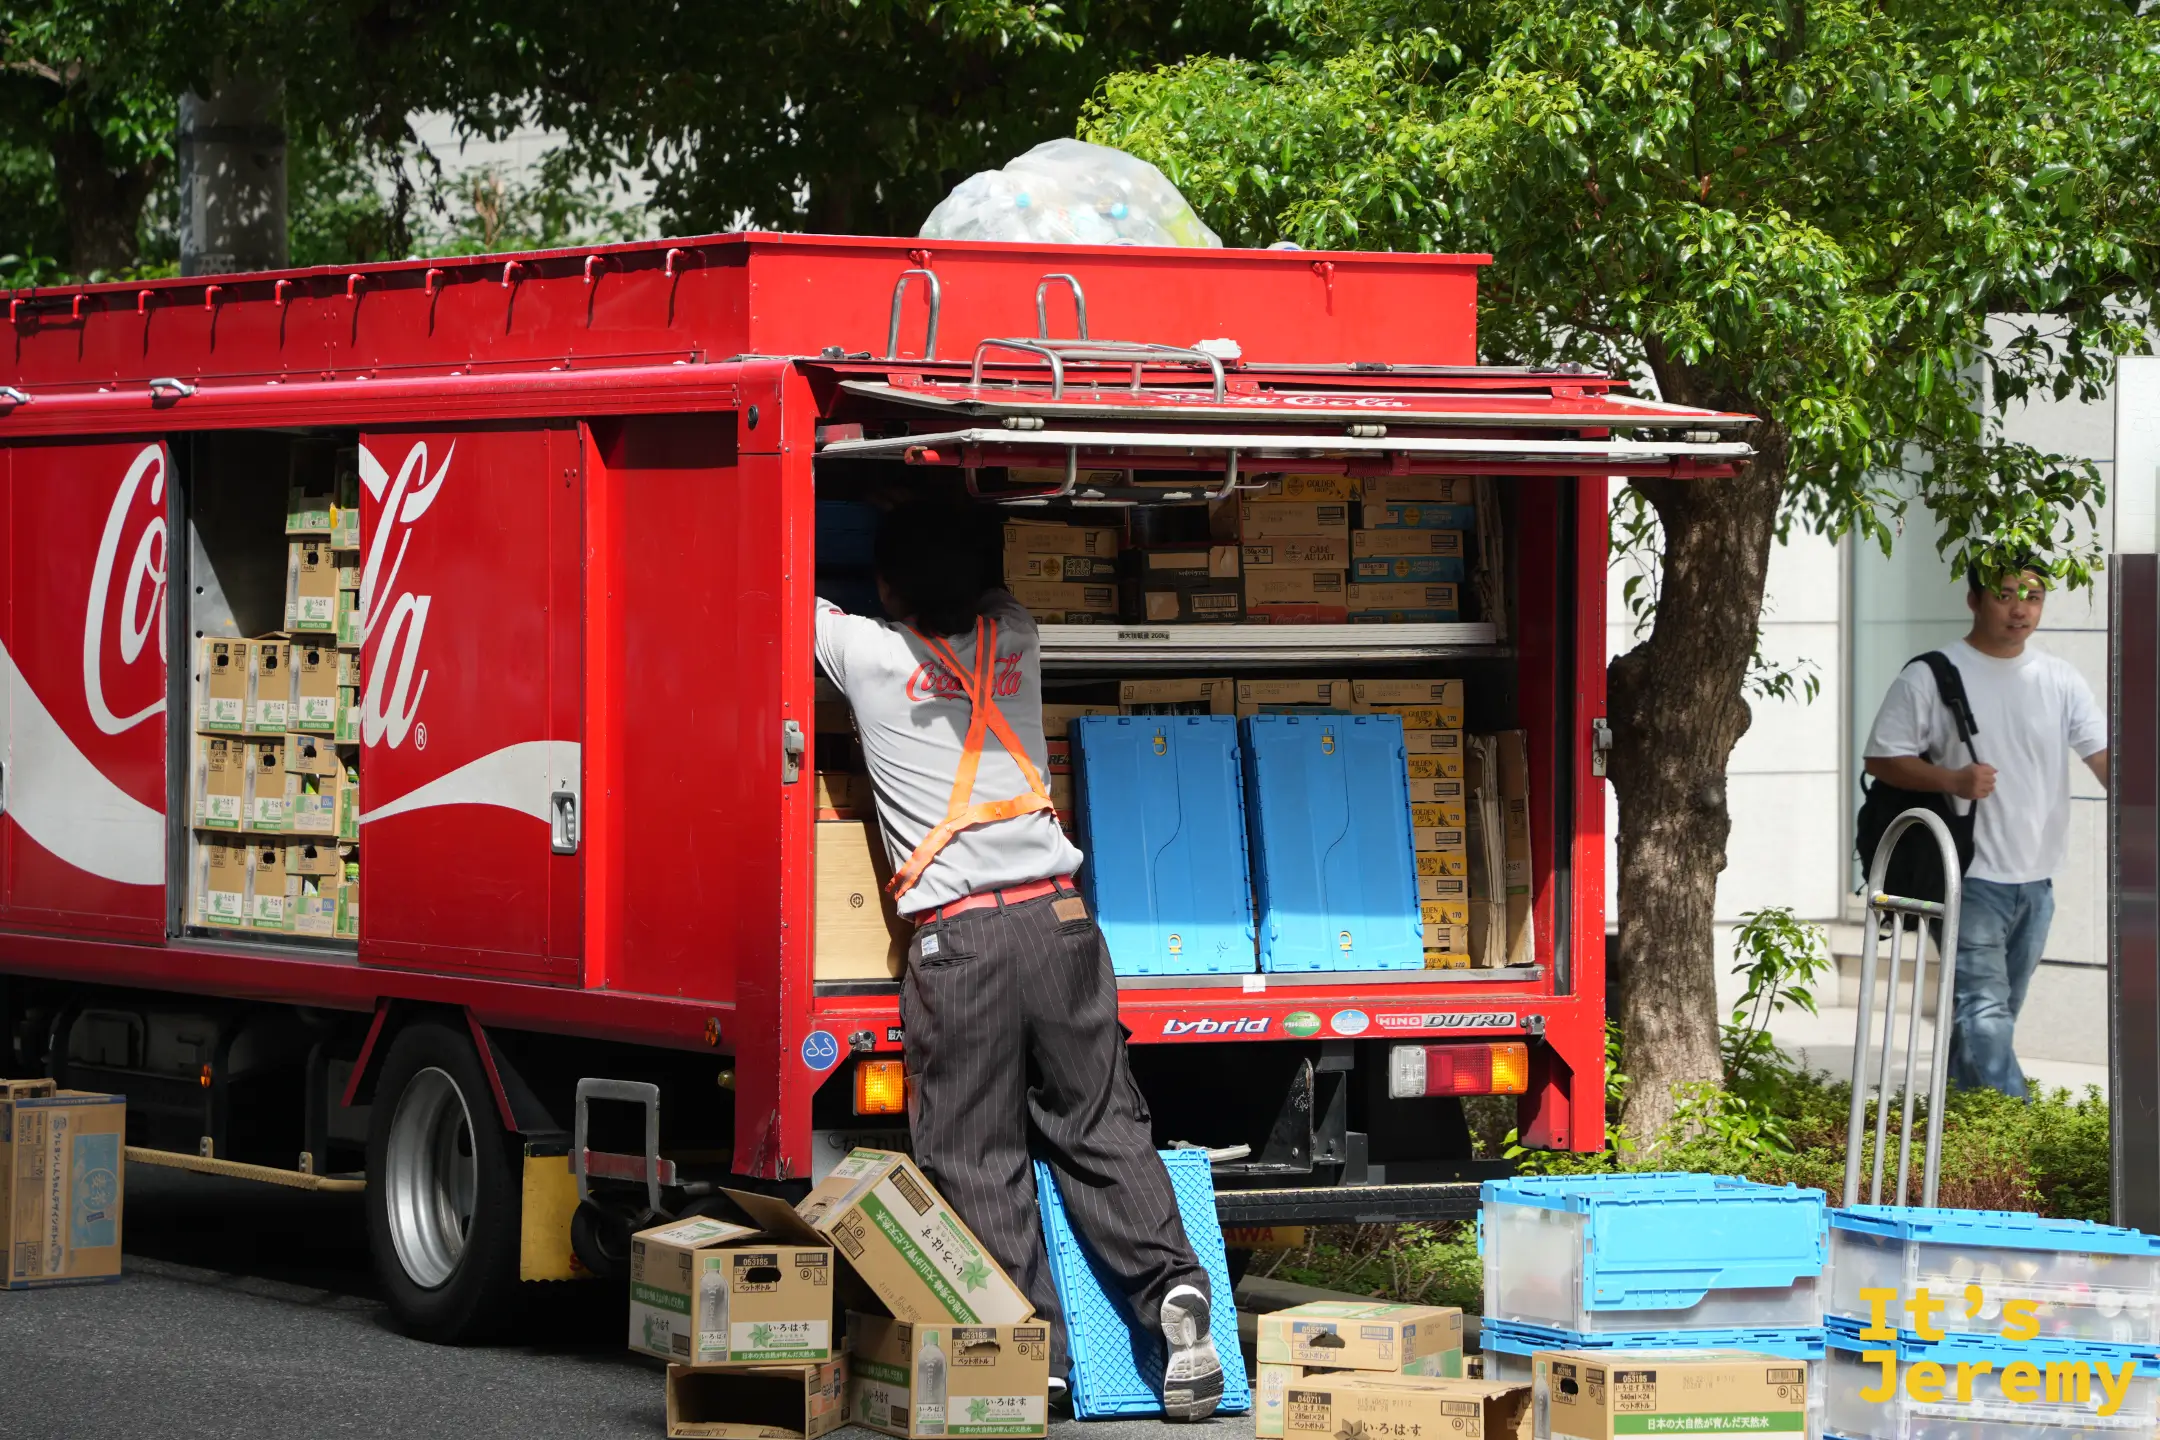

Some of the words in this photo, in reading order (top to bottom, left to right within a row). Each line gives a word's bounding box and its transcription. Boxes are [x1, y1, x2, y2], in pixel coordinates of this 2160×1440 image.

[1380, 1016, 1420, 1026] HINO
[1424, 1014, 1514, 1028] DUTRO
[742, 1351, 816, 1360] 日本の大自然が育んだ天然水
[1294, 1421, 1325, 1430] ペットボトル
[1648, 1416, 1769, 1431] 日本の大自然が育んだ天然水
[959, 1426, 1032, 1434] 日本の大自然が育んだ天然水
